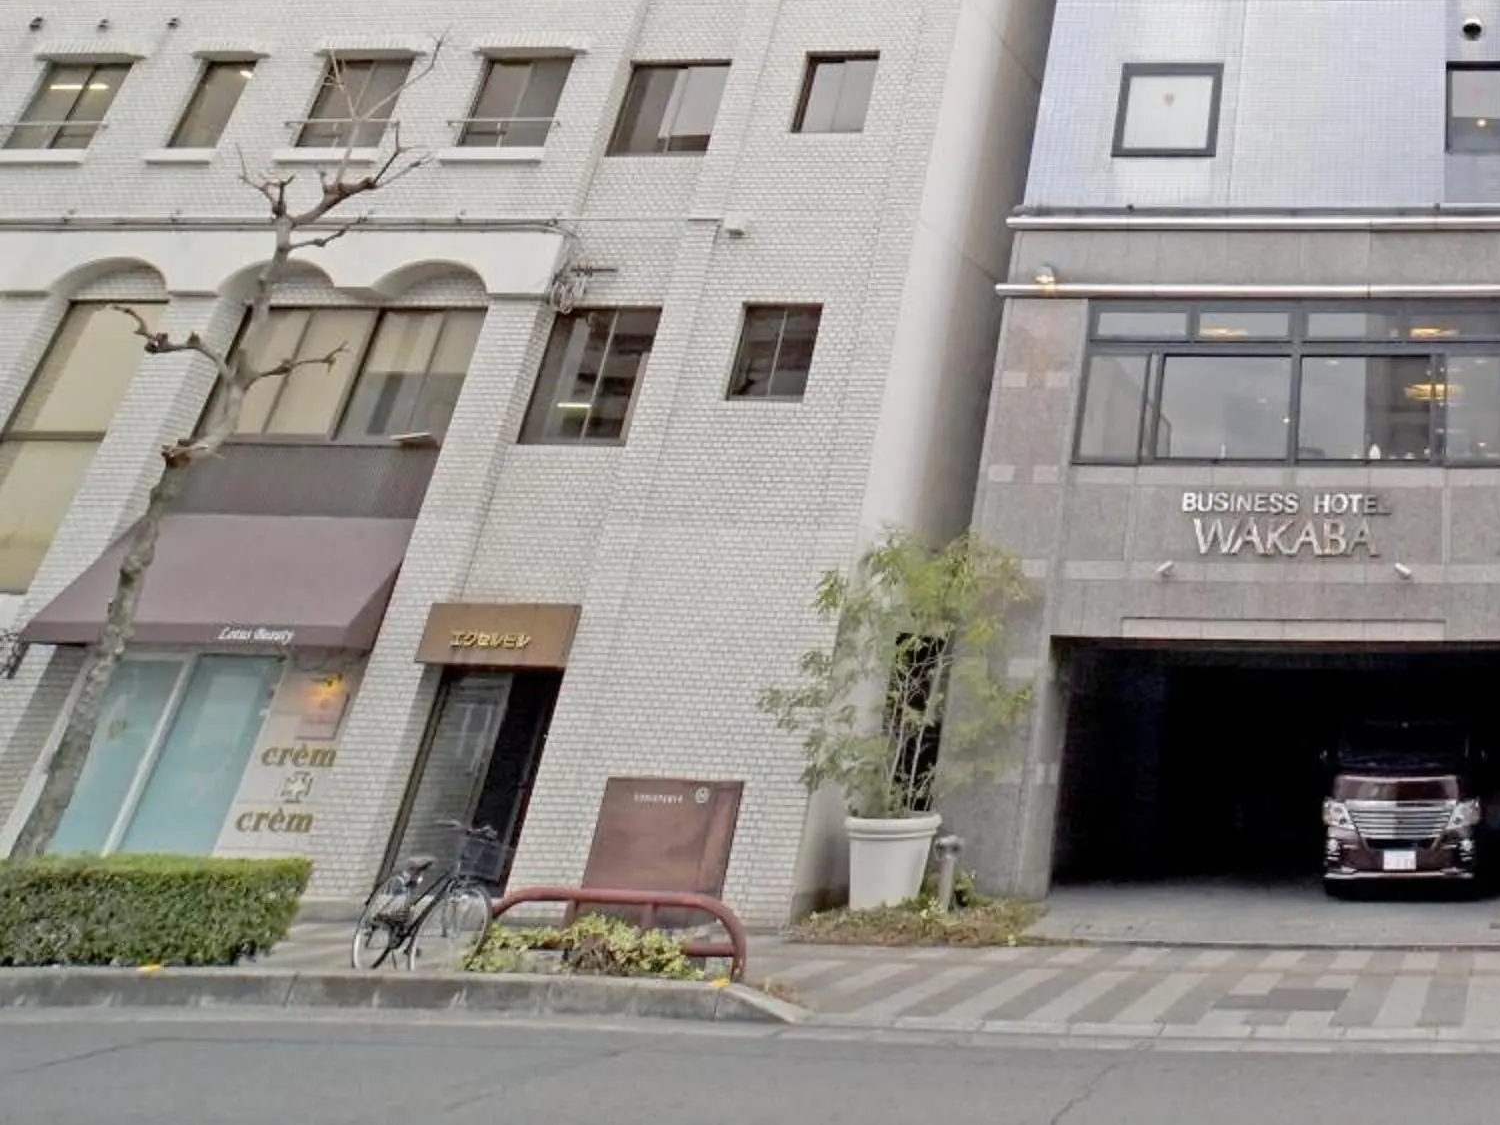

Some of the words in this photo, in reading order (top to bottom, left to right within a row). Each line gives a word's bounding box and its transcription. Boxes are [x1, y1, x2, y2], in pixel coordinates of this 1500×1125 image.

[1181, 491, 1300, 515] BUSINESS
[1312, 494, 1392, 516] HOTEL
[1193, 517, 1380, 557] WAKABA
